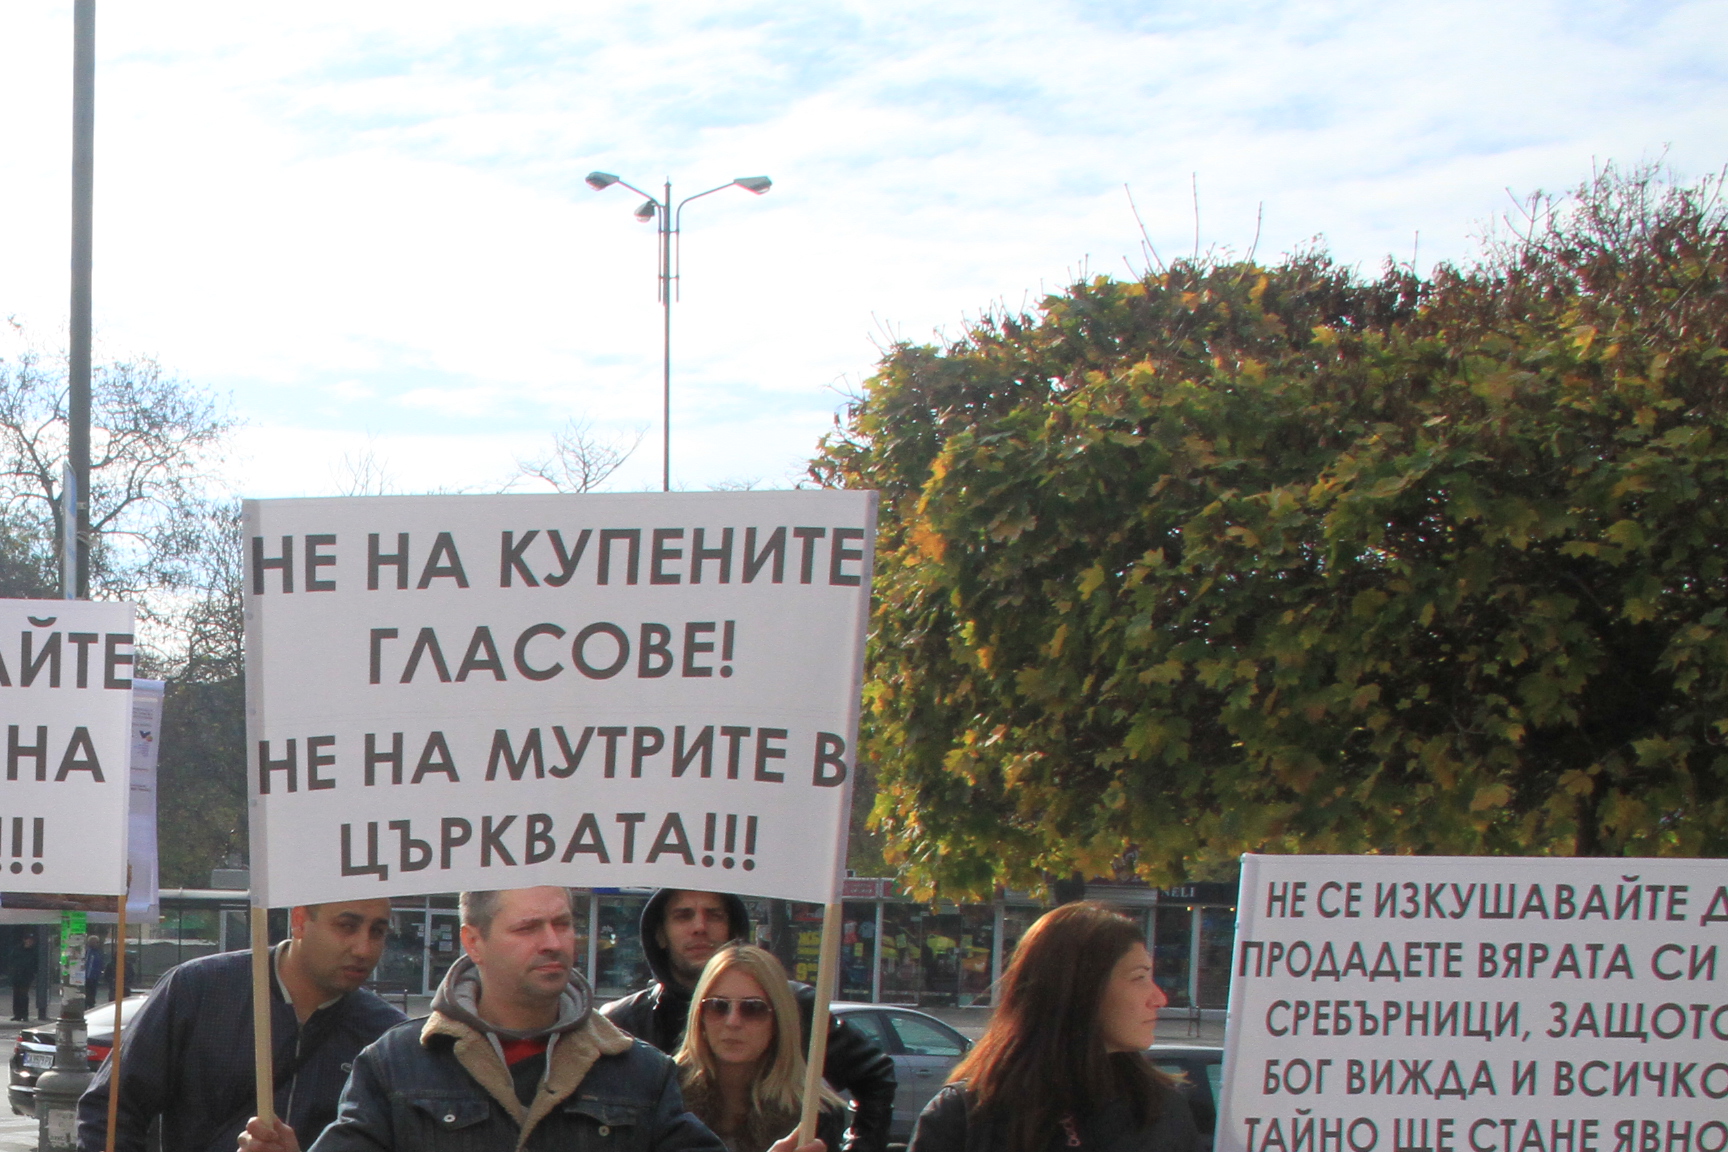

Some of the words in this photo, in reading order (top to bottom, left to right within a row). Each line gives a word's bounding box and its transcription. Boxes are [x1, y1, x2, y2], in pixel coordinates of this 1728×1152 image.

[252, 534, 337, 596] НЕ
[367, 532, 470, 591] НА
[500, 526, 866, 588] КУПЕНИТЕ
[369, 619, 736, 686] ГЛАСОВЕ!
[6, 725, 107, 783] НА
[258, 735, 337, 795] НЕ
[364, 730, 461, 787] НА
[484, 725, 788, 783] МУТРИТЕ
[812, 731, 848, 789] В
[339, 812, 759, 882] ЦЪРКВАТА!!!
[1265, 881, 1307, 919] НЕ
[1317, 880, 1363, 919] СЕ
[1374, 874, 1689, 921] ИЗКУШАВАЙТЕ
[1239, 941, 1463, 982] ПРОДАДЕТЕ
[1478, 942, 1634, 979] ВЯРАТА
[1651, 943, 1717, 981] СИ
[1265, 999, 1531, 1043] СРЕБЪРНИЦИ,
[1262, 1057, 1332, 1095] БОГ
[1346, 1059, 1496, 1100] ВИЖДА
[1512, 1060, 1536, 1096] И
[1553, 1060, 1728, 1099] ВСИЧКО
